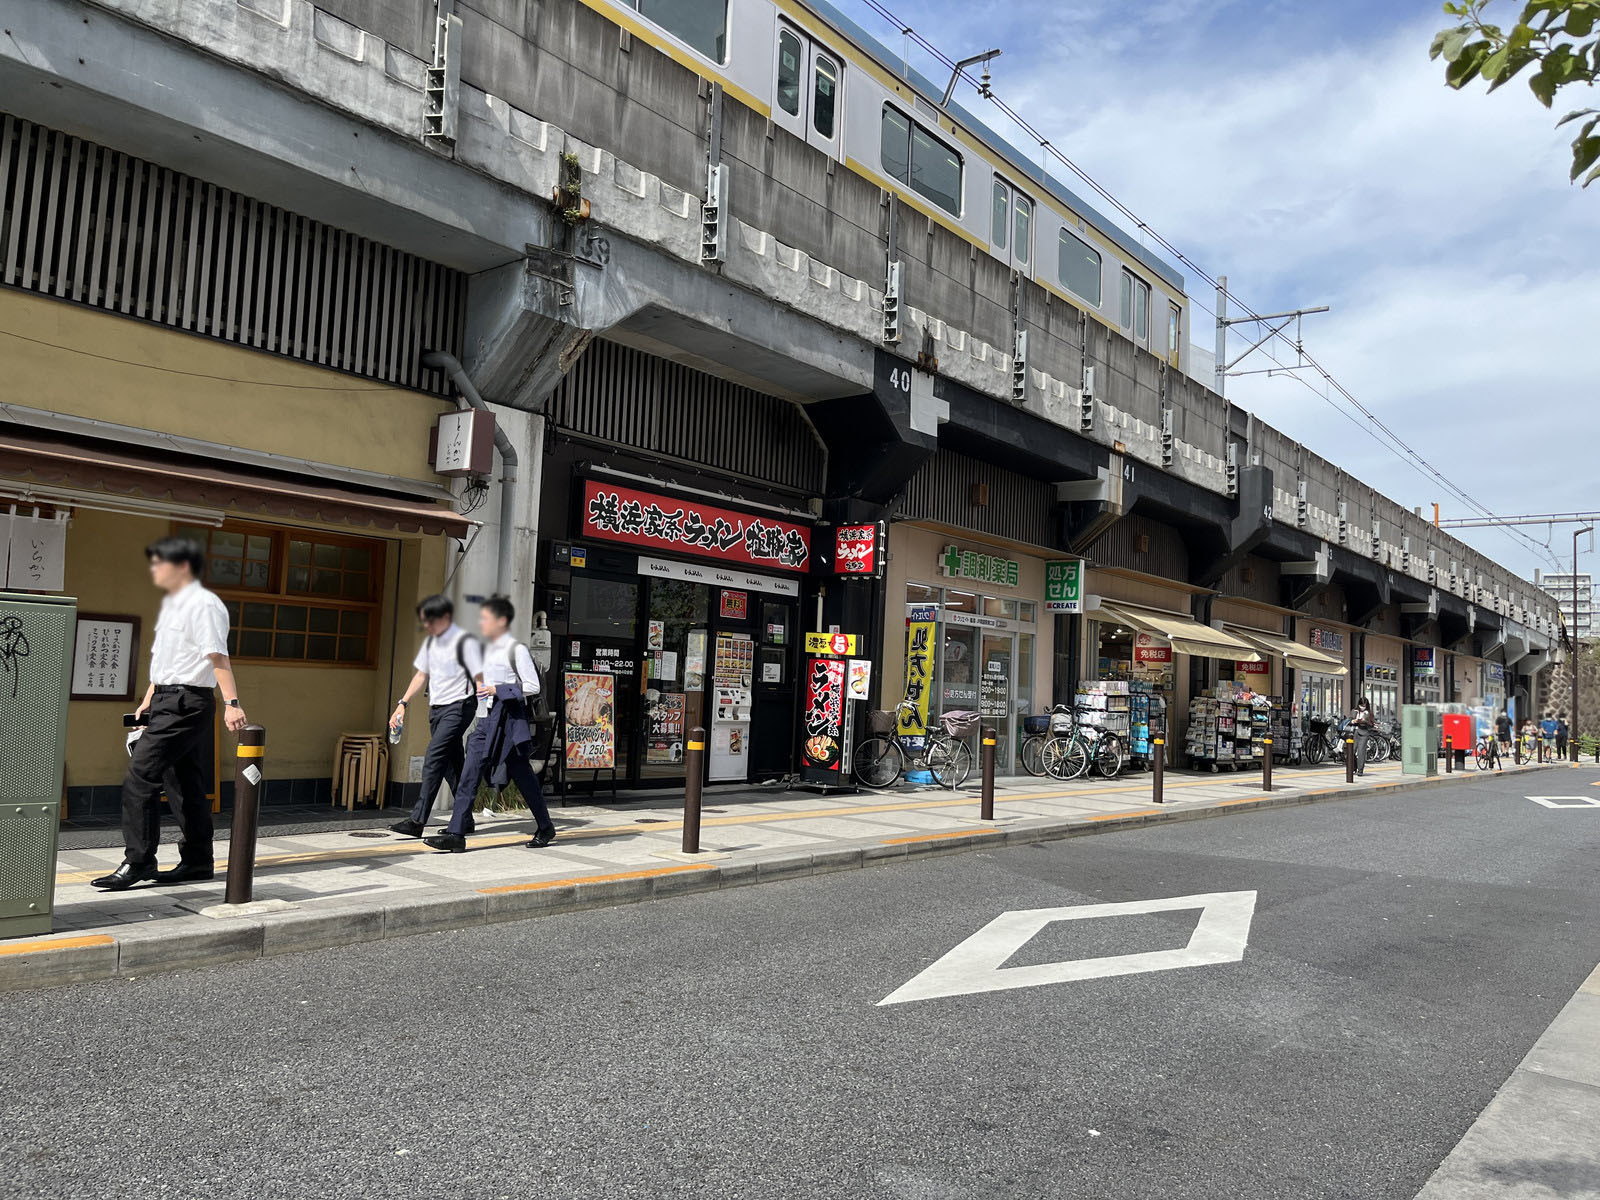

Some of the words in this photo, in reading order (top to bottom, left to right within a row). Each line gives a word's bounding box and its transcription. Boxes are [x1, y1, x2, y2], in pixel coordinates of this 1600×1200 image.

[889, 367, 911, 392] 40
[1123, 464, 1135, 482] 41
[1263, 504, 1273, 520] 42
[588, 491, 744, 551] 横浜家系ラーメン
[962, 550, 1020, 588] 調剤薬局
[1048, 565, 1076, 581] 処方
[1048, 583, 1076, 598] せん
[595, 648, 620, 658] 営業時間
[1140, 649, 1167, 659] 免税店
[1241, 663, 1264, 672] 免税店
[804, 661, 831, 737] ラーメン
[653, 710, 681, 721] スタッフ
[652, 722, 681, 734] 大募集!!
